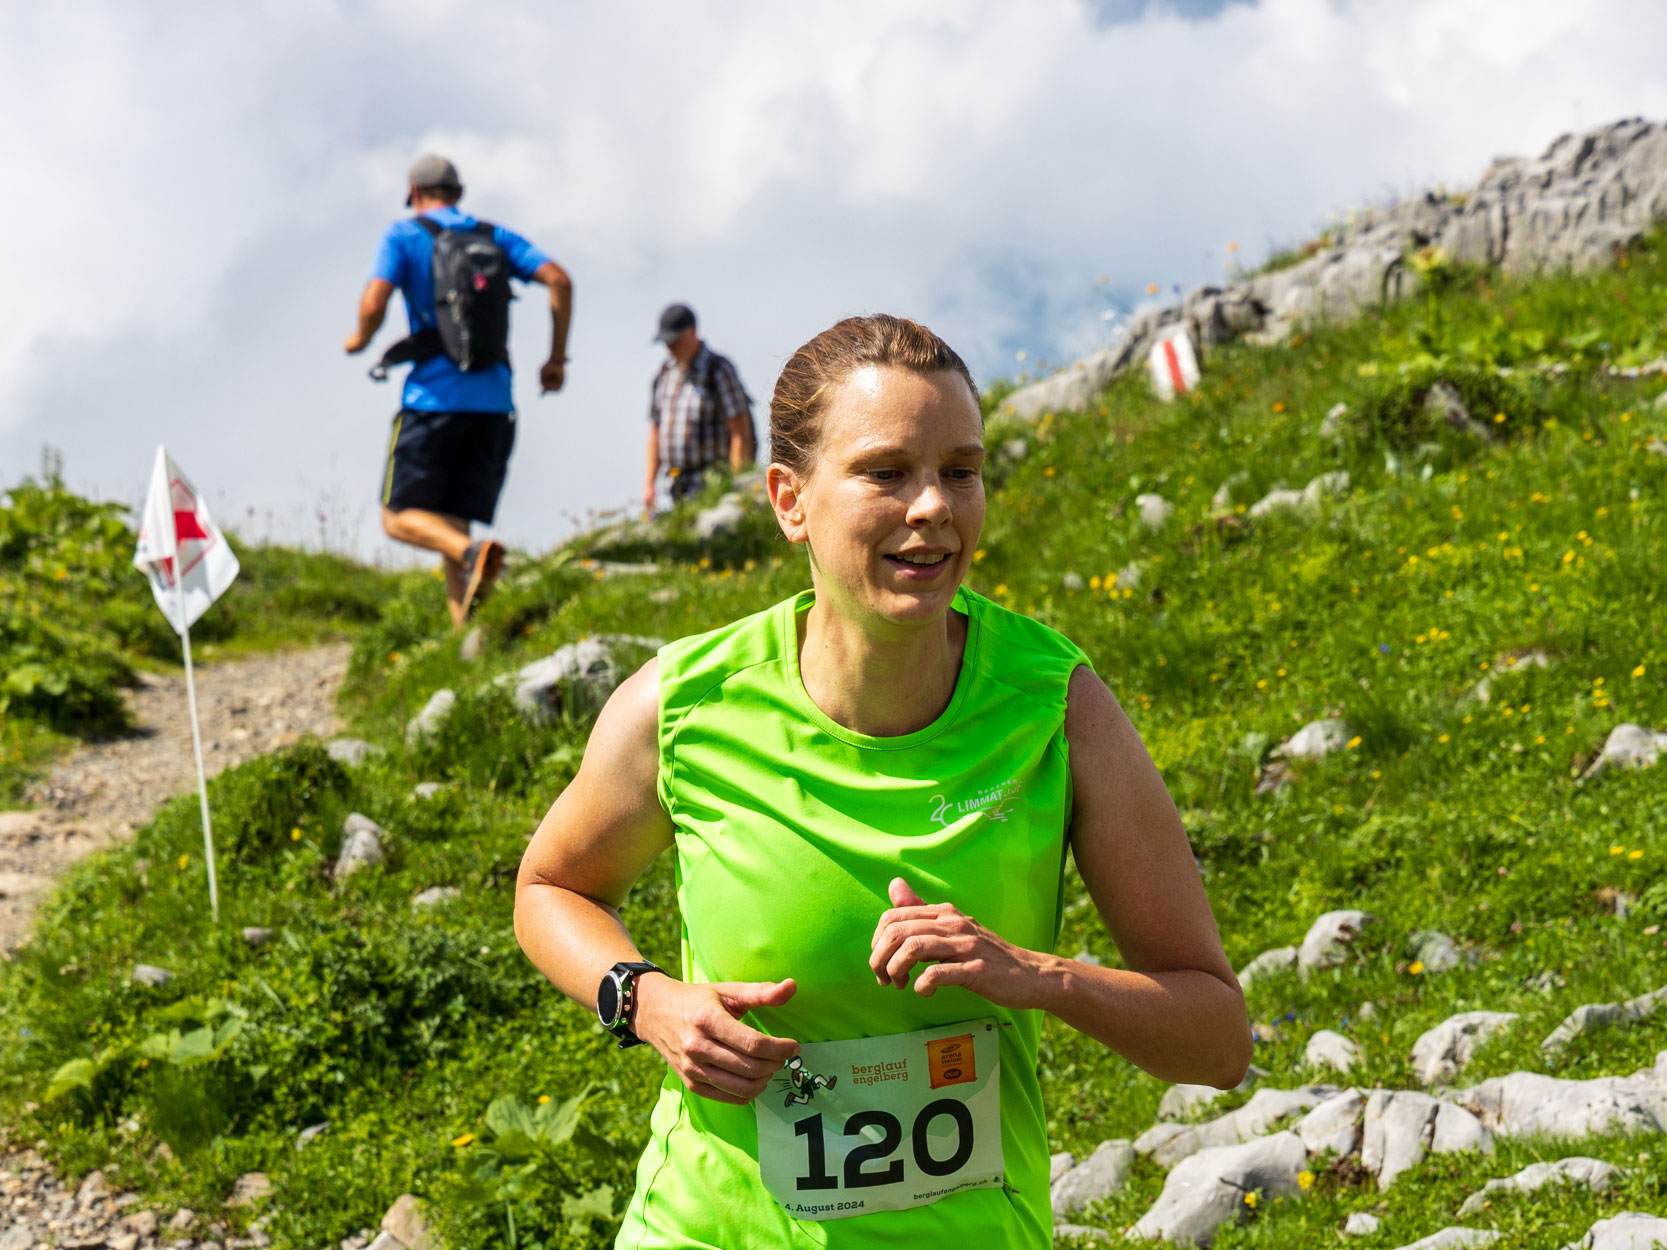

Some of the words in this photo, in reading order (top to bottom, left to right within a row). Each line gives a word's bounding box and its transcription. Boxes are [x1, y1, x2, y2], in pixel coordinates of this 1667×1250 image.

[851, 1058, 908, 1075] berglauf
[853, 1071, 909, 1086] engelberg
[794, 1098, 974, 1190] 120
[784, 1203, 794, 1212] 4.
[796, 1204, 835, 1215] August
[837, 1200, 865, 1211] 2024
